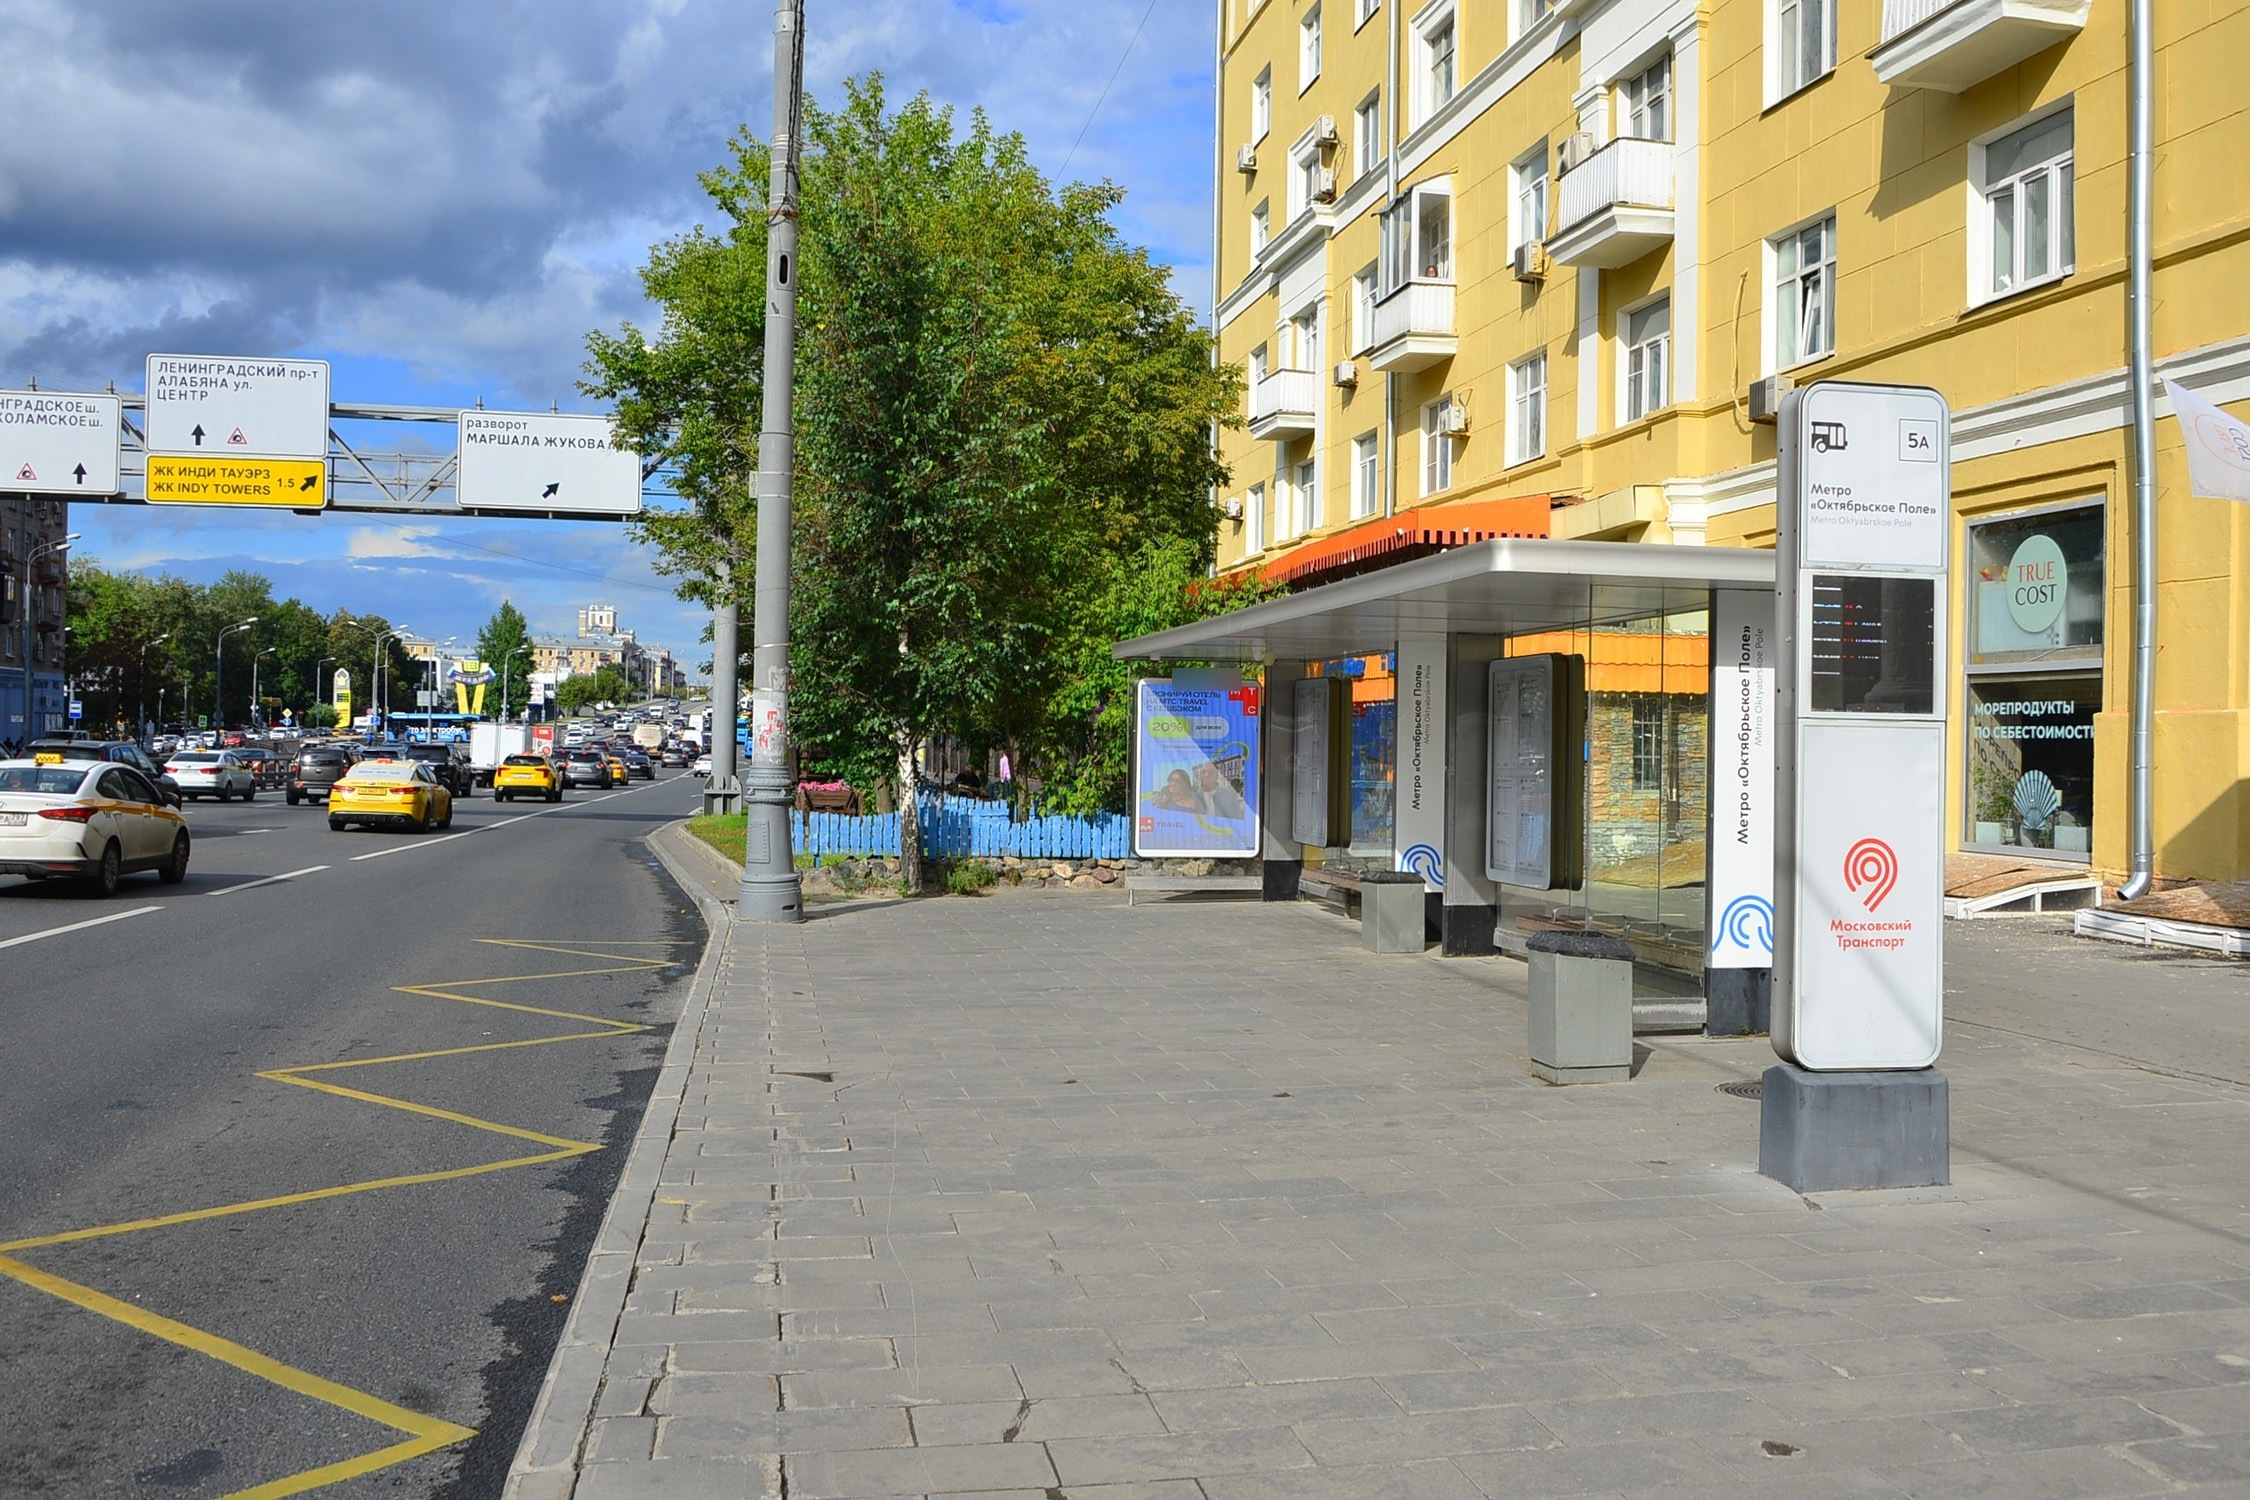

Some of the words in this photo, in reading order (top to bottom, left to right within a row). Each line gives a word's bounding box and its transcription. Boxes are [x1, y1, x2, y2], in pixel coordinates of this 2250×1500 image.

[158, 361, 286, 378] ЛЕНИНГРАДСКИЙ
[290, 370, 318, 380] пр-т
[158, 375, 228, 389] АЛАБЯНА
[234, 381, 252, 392] ул.
[157, 389, 209, 401] ЦЕНТР
[85, 405, 99, 413] ш.
[88, 419, 103, 427] ш.
[466, 419, 528, 432] разворот
[466, 433, 540, 447] МАРШАЛА
[544, 436, 605, 450] ЖУКОВА
[1908, 432, 1929, 450] 5А
[154, 465, 174, 476] ЖК
[178, 466, 216, 479] ИНДИ
[220, 468, 270, 479] ТАУЭРЗ
[153, 482, 174, 493] ЖК
[178, 483, 209, 493] INDY
[213, 484, 271, 495] TOWERS
[277, 478, 295, 488] 1.5
[1810, 484, 1852, 498] Метро
[1810, 499, 1895, 513] «Октябрьское
[1899, 502, 1937, 515] Поле»
[1810, 515, 1837, 525] Metro
[1838, 516, 1892, 527] Oktyabrskoe
[1894, 518, 1912, 528] Pole
[2017, 561, 2056, 583] TRUE
[2015, 584, 2058, 606] COST
[1754, 628, 1764, 650] Pole
[1738, 625, 1751, 673] Поле»
[1424, 664, 1432, 680] Pole
[1413, 664, 1423, 697] Поле»
[1754, 651, 1764, 713] Oktyabrskoe
[1146, 690, 1192, 698] БРОНИРУЙ
[1193, 690, 1221, 698] ОТЕЛЬ
[1424, 681, 1432, 723] Oktyabrskoe
[1974, 700, 2075, 717] МОРЕПРОДУКТЫ
[420, 725, 465, 734] элктробус
[1152, 721, 1183, 732] 20%
[1737, 678, 1751, 787] «Октябрьское
[1754, 716, 1763, 747] Metro
[1974, 726, 1990, 739] ПО
[1412, 699, 1423, 772] «Октябрьское
[1412, 775, 1423, 810] Метро
[1737, 792, 1751, 844] Метро
[1830, 919, 1912, 931] Московский
[1836, 935, 1905, 951] Транспорт
